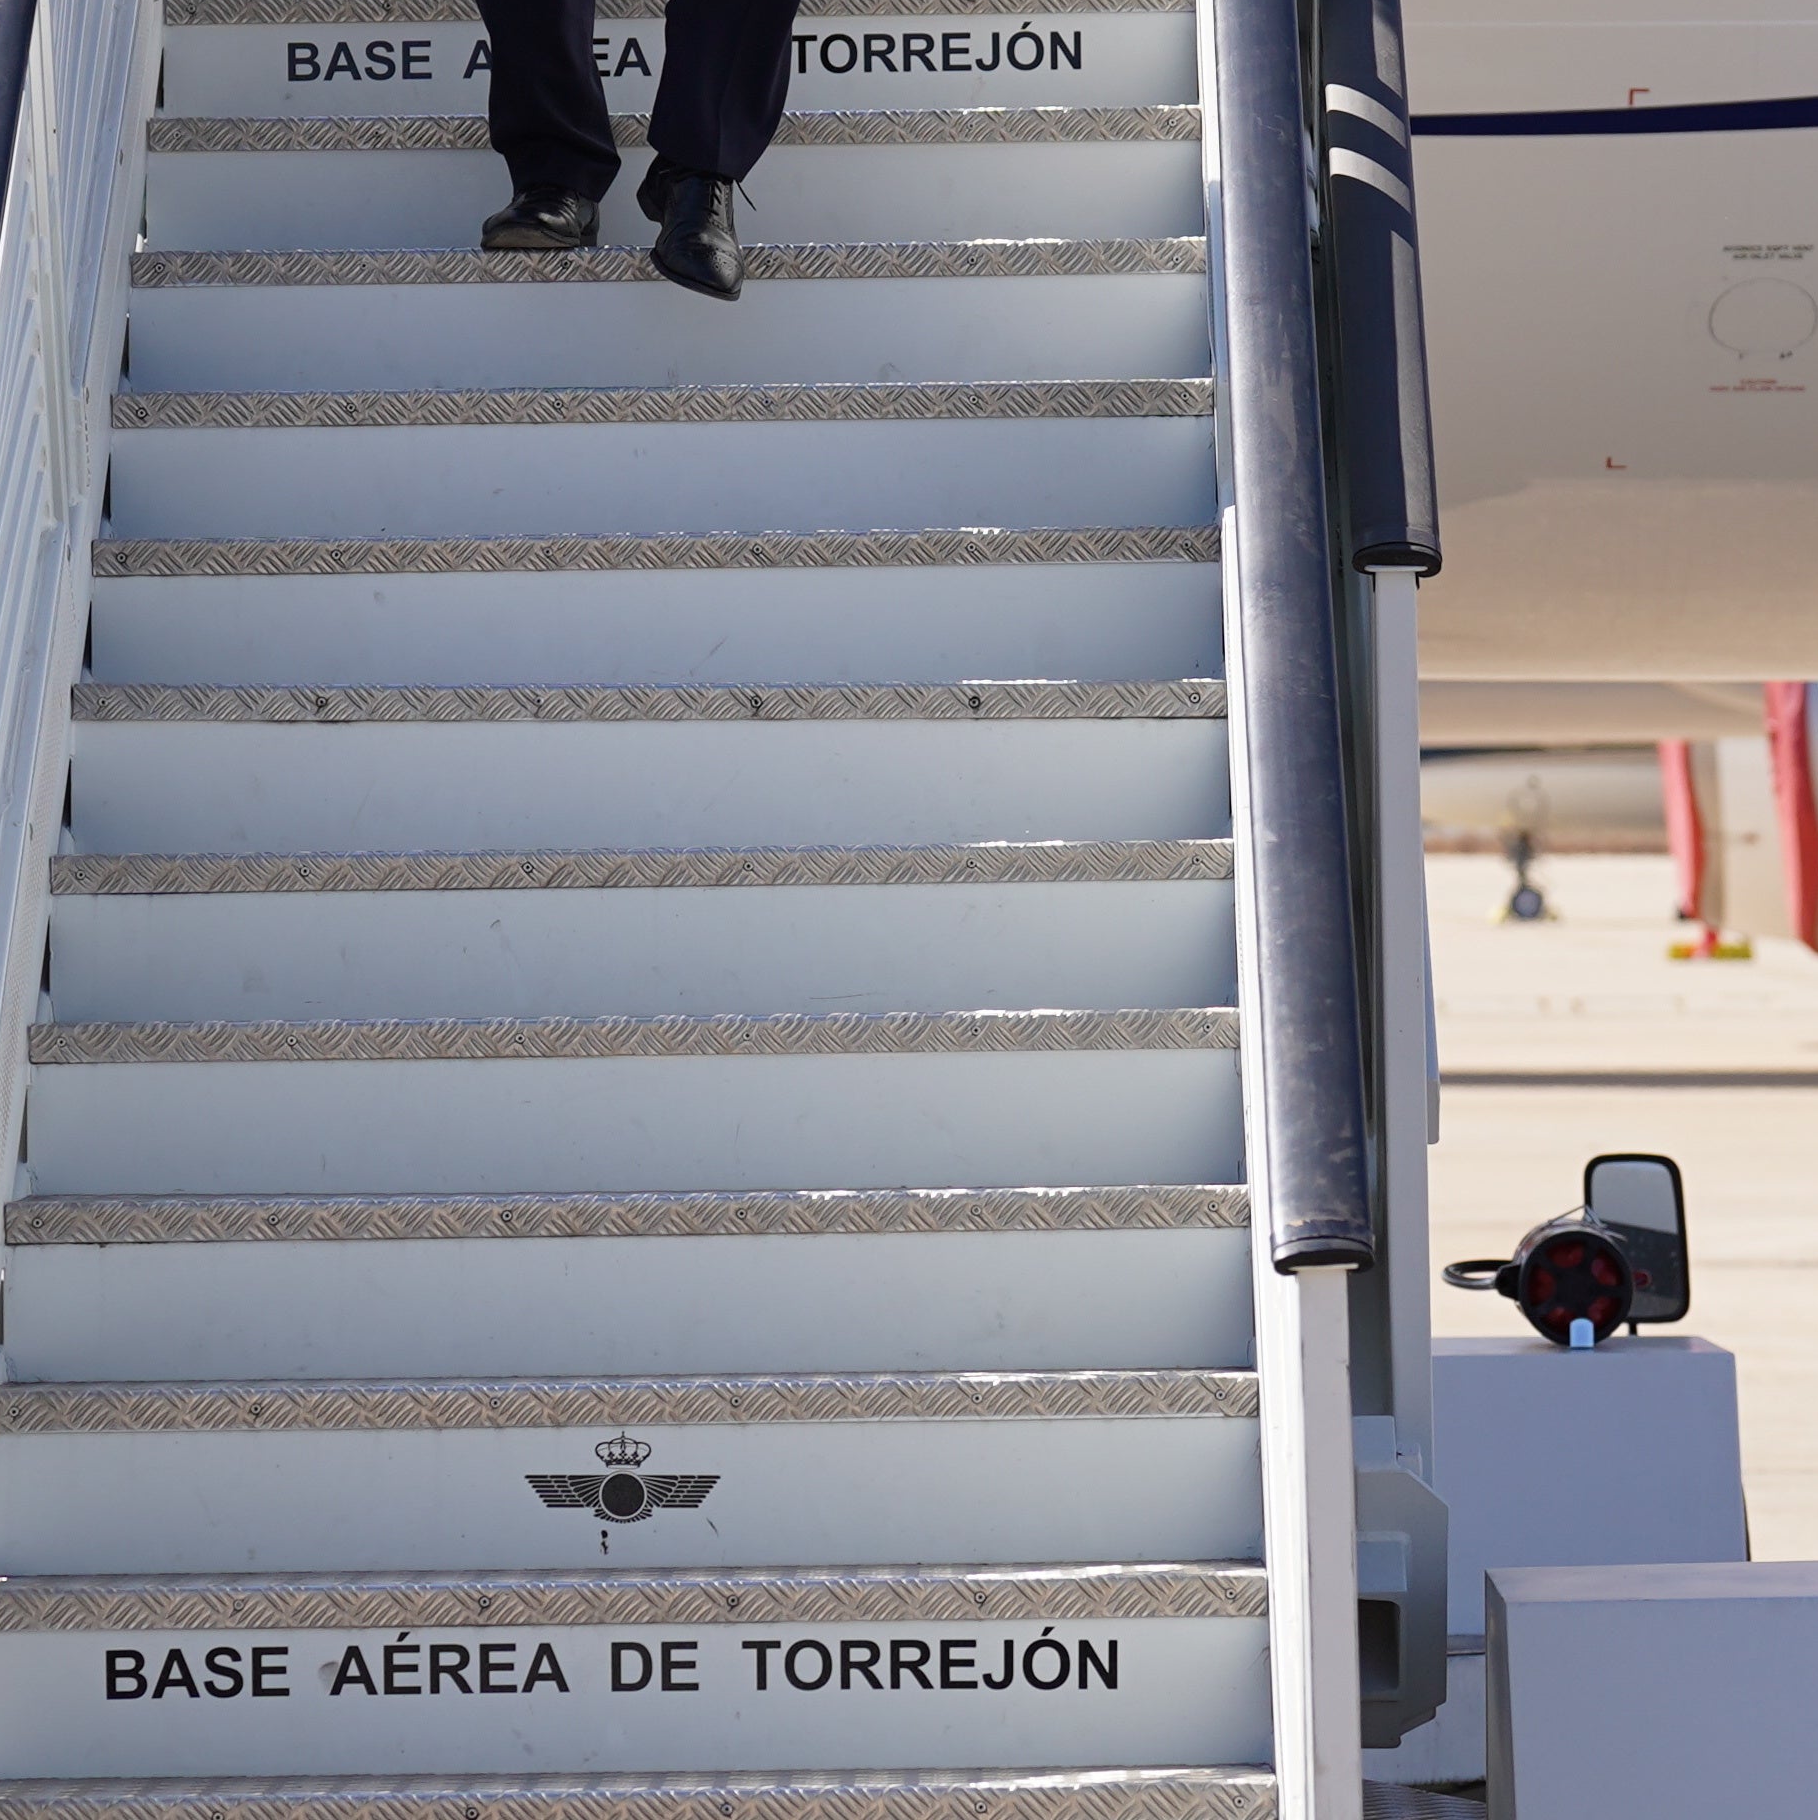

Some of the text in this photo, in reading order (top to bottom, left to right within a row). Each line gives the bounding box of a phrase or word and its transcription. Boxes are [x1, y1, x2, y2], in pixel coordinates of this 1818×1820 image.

[287, 39, 432, 81] BASE
[791, 21, 1082, 73] TORREJÓN
[104, 1626, 1119, 1700] BASE AÉREA DE TORREJÓN
